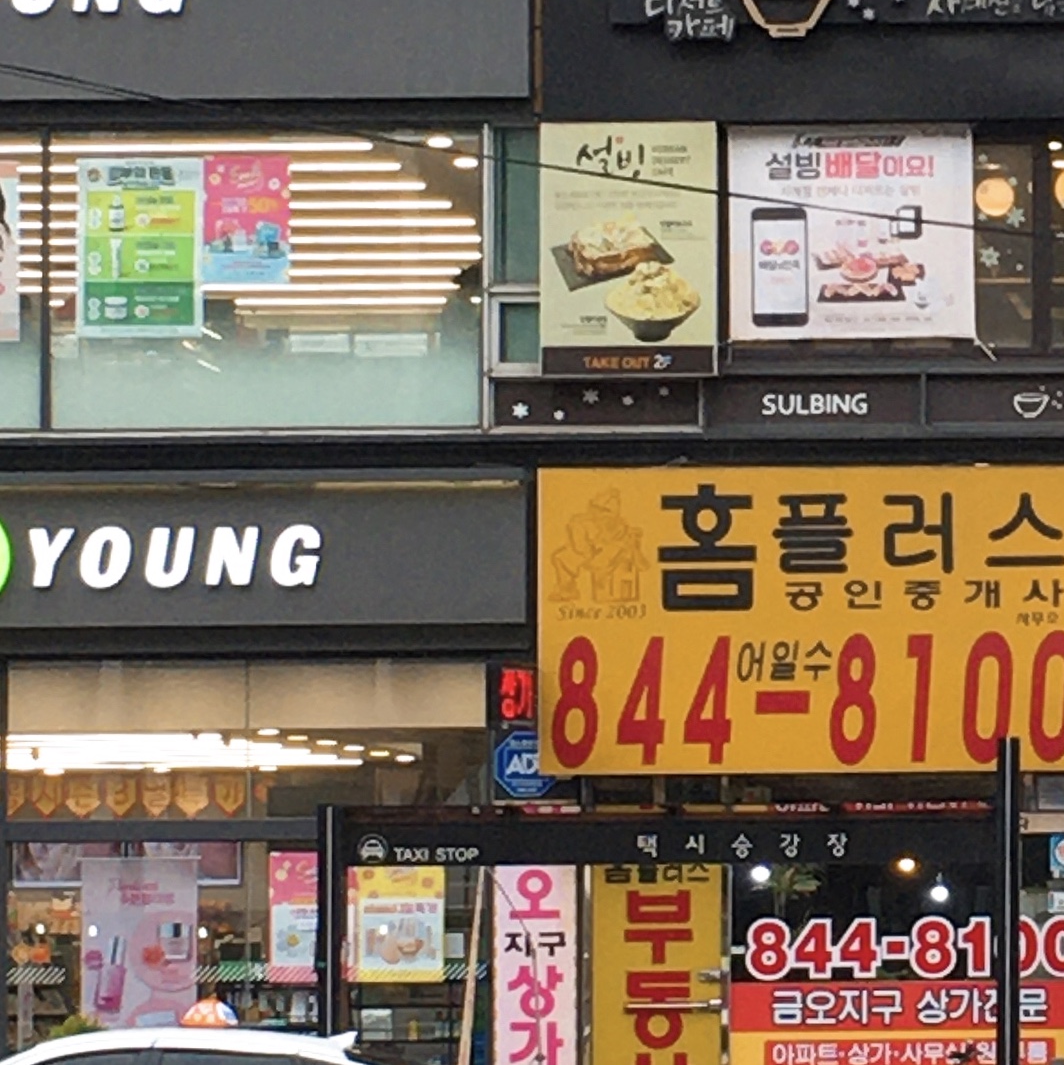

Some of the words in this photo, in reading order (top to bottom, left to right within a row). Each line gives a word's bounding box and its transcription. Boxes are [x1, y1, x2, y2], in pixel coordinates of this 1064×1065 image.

[765, 151, 821, 181] 설빙
[583, 356, 619, 370] TAKE
[621, 356, 650, 370] OUT
[762, 393, 868, 416] SULBING
[27, 524, 322, 589] YOUNG
[784, 579, 1064, 611] 공인중개사
[505, 753, 541, 775] AD
[393, 846, 430, 862] TAXI
[435, 846, 480, 862] STOP
[623, 889, 694, 1065] 부동
[772, 989, 902, 1025] 금오지구
